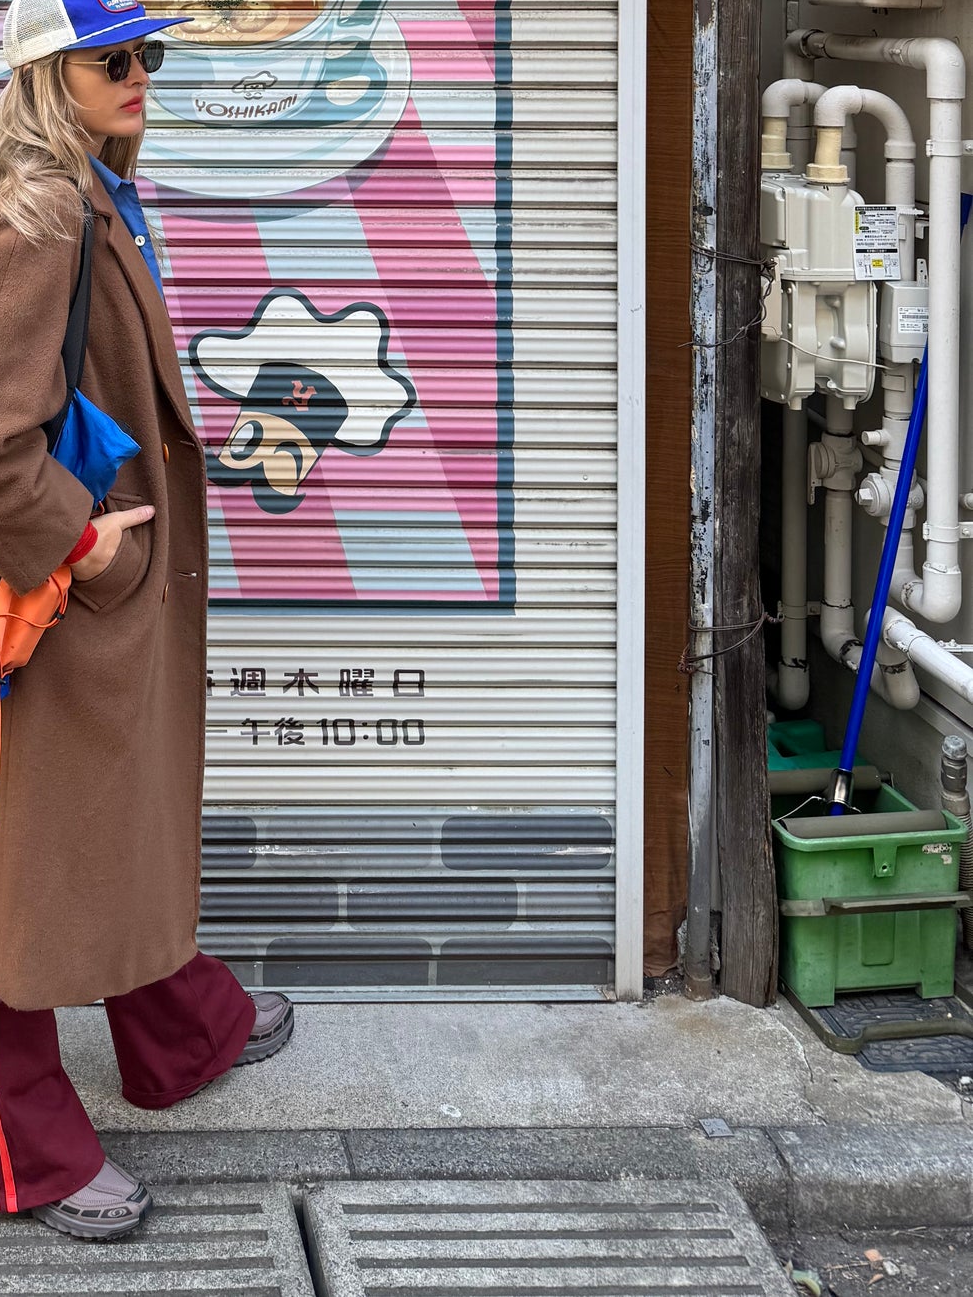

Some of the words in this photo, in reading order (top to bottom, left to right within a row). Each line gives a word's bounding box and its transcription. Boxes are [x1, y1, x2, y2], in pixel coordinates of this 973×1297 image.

[195, 94, 298, 118] YOSHIKAMI
[207, 668, 425, 697] 週木曜日
